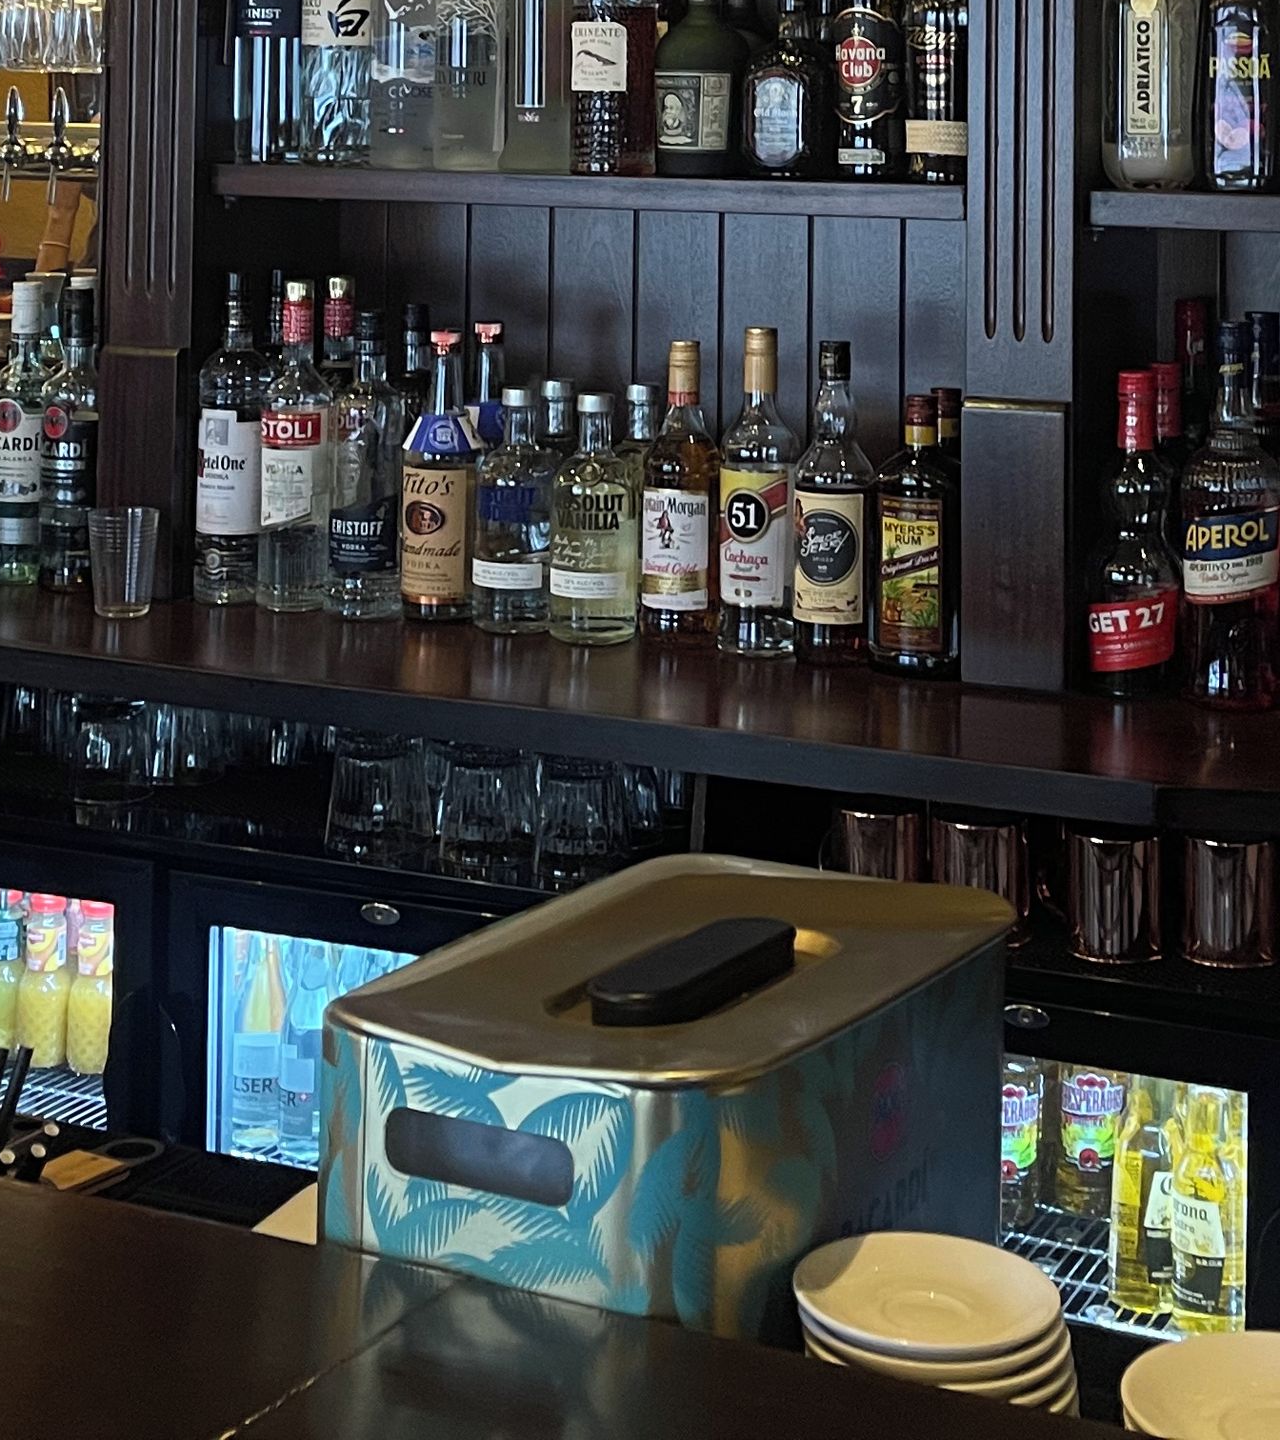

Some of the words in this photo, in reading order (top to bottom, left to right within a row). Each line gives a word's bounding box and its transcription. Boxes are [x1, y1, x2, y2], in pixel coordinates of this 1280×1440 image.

[835, 44, 886, 62] Havana
[841, 62, 873, 78] Club
[1136, 20, 1151, 114] ADRIATICO
[851, 95, 863, 115] 7
[261, 418, 313, 440] STOLI
[220, 454, 246, 471] One
[403, 471, 455, 497] Tito's
[666, 496, 706, 517] Morgan
[731, 502, 758, 529] 51
[331, 517, 384, 536] ERISTOFF
[884, 521, 936, 536] MYERS'S
[1185, 517, 1270, 552] APEROL
[894, 534, 922, 546] RUM
[1088, 609, 1131, 634] GET
[1135, 602, 1165, 629] 27
[233, 1076, 273, 1095] LSER
